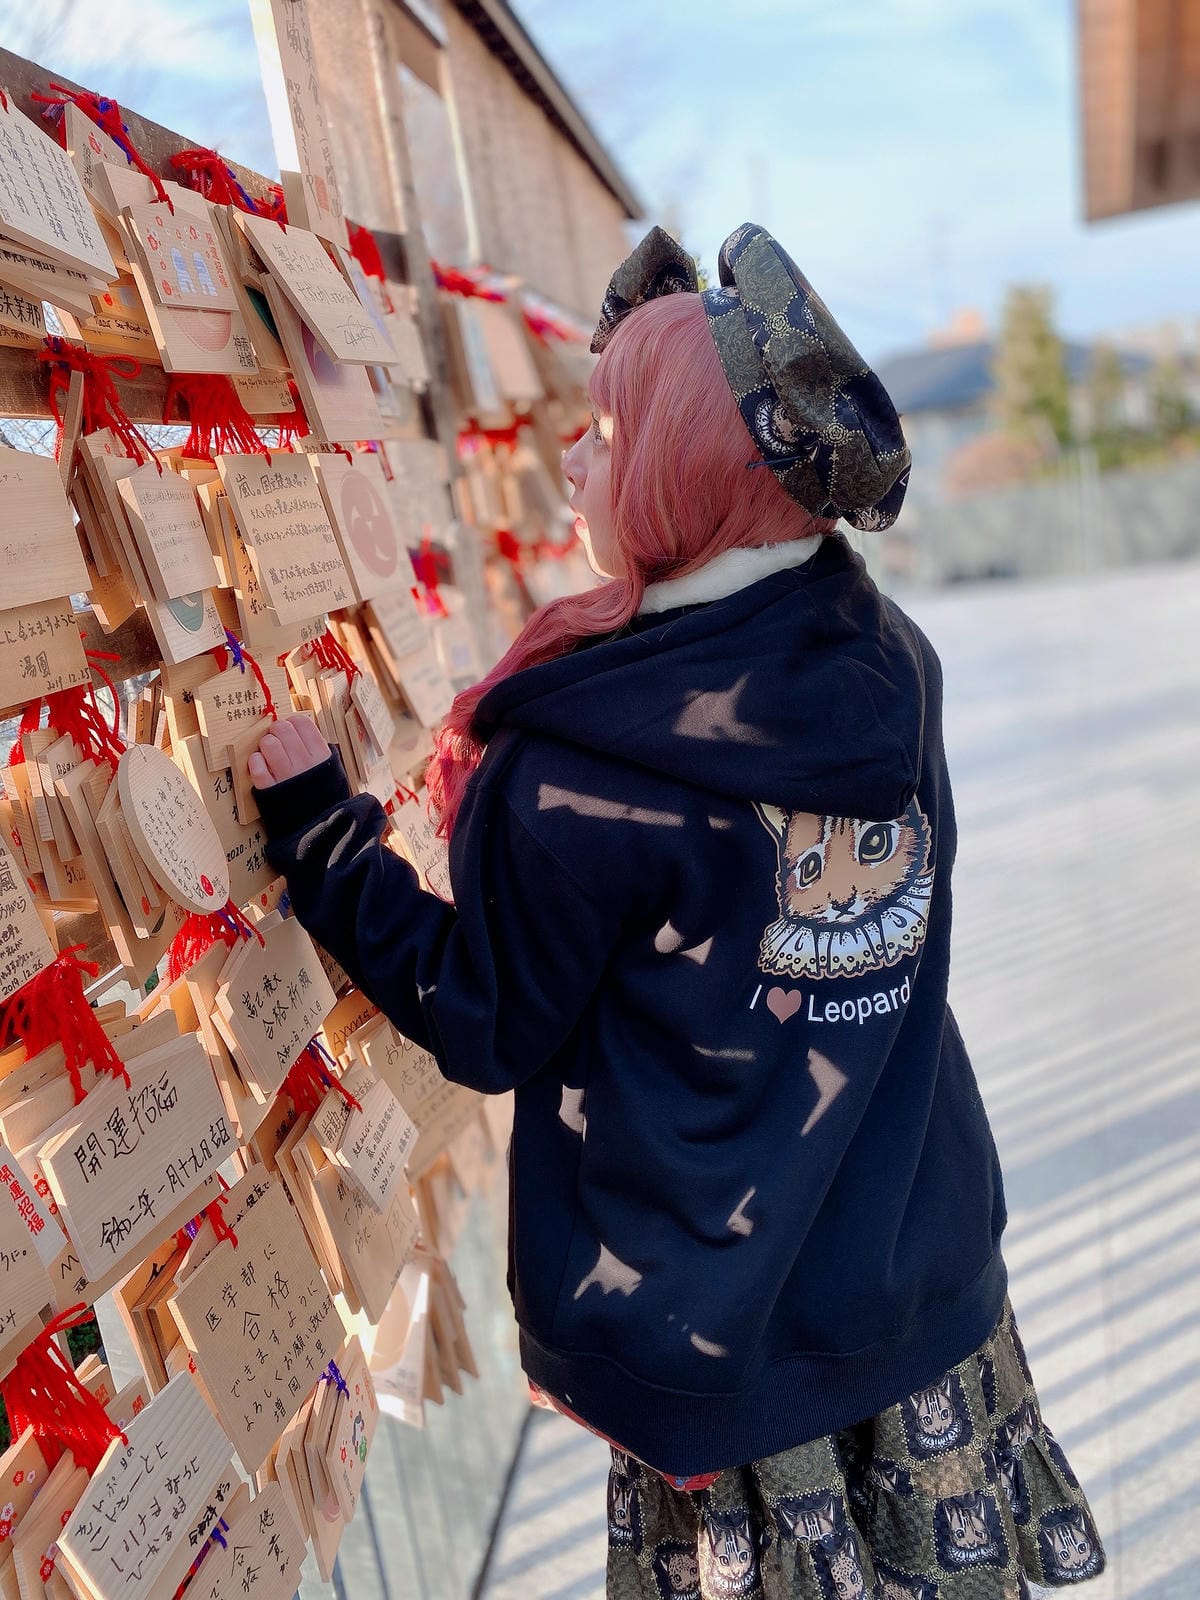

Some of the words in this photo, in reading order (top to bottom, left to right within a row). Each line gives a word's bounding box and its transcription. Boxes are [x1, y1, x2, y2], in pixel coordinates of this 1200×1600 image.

[1, 959, 44, 997] 2019.12.26
[261, 966, 313, 1040] 合格祈願
[749, 984, 763, 1011] I
[807, 975, 912, 1026] Leopard
[74, 1070, 180, 1184] 開運招福
[0, 1163, 47, 1237] 開運招福
[205, 1241, 278, 1333] 医学部に
[242, 1270, 291, 1341] 合格
[230, 1279, 320, 1400] できますように
[230, 1543, 263, 1593] 合格
